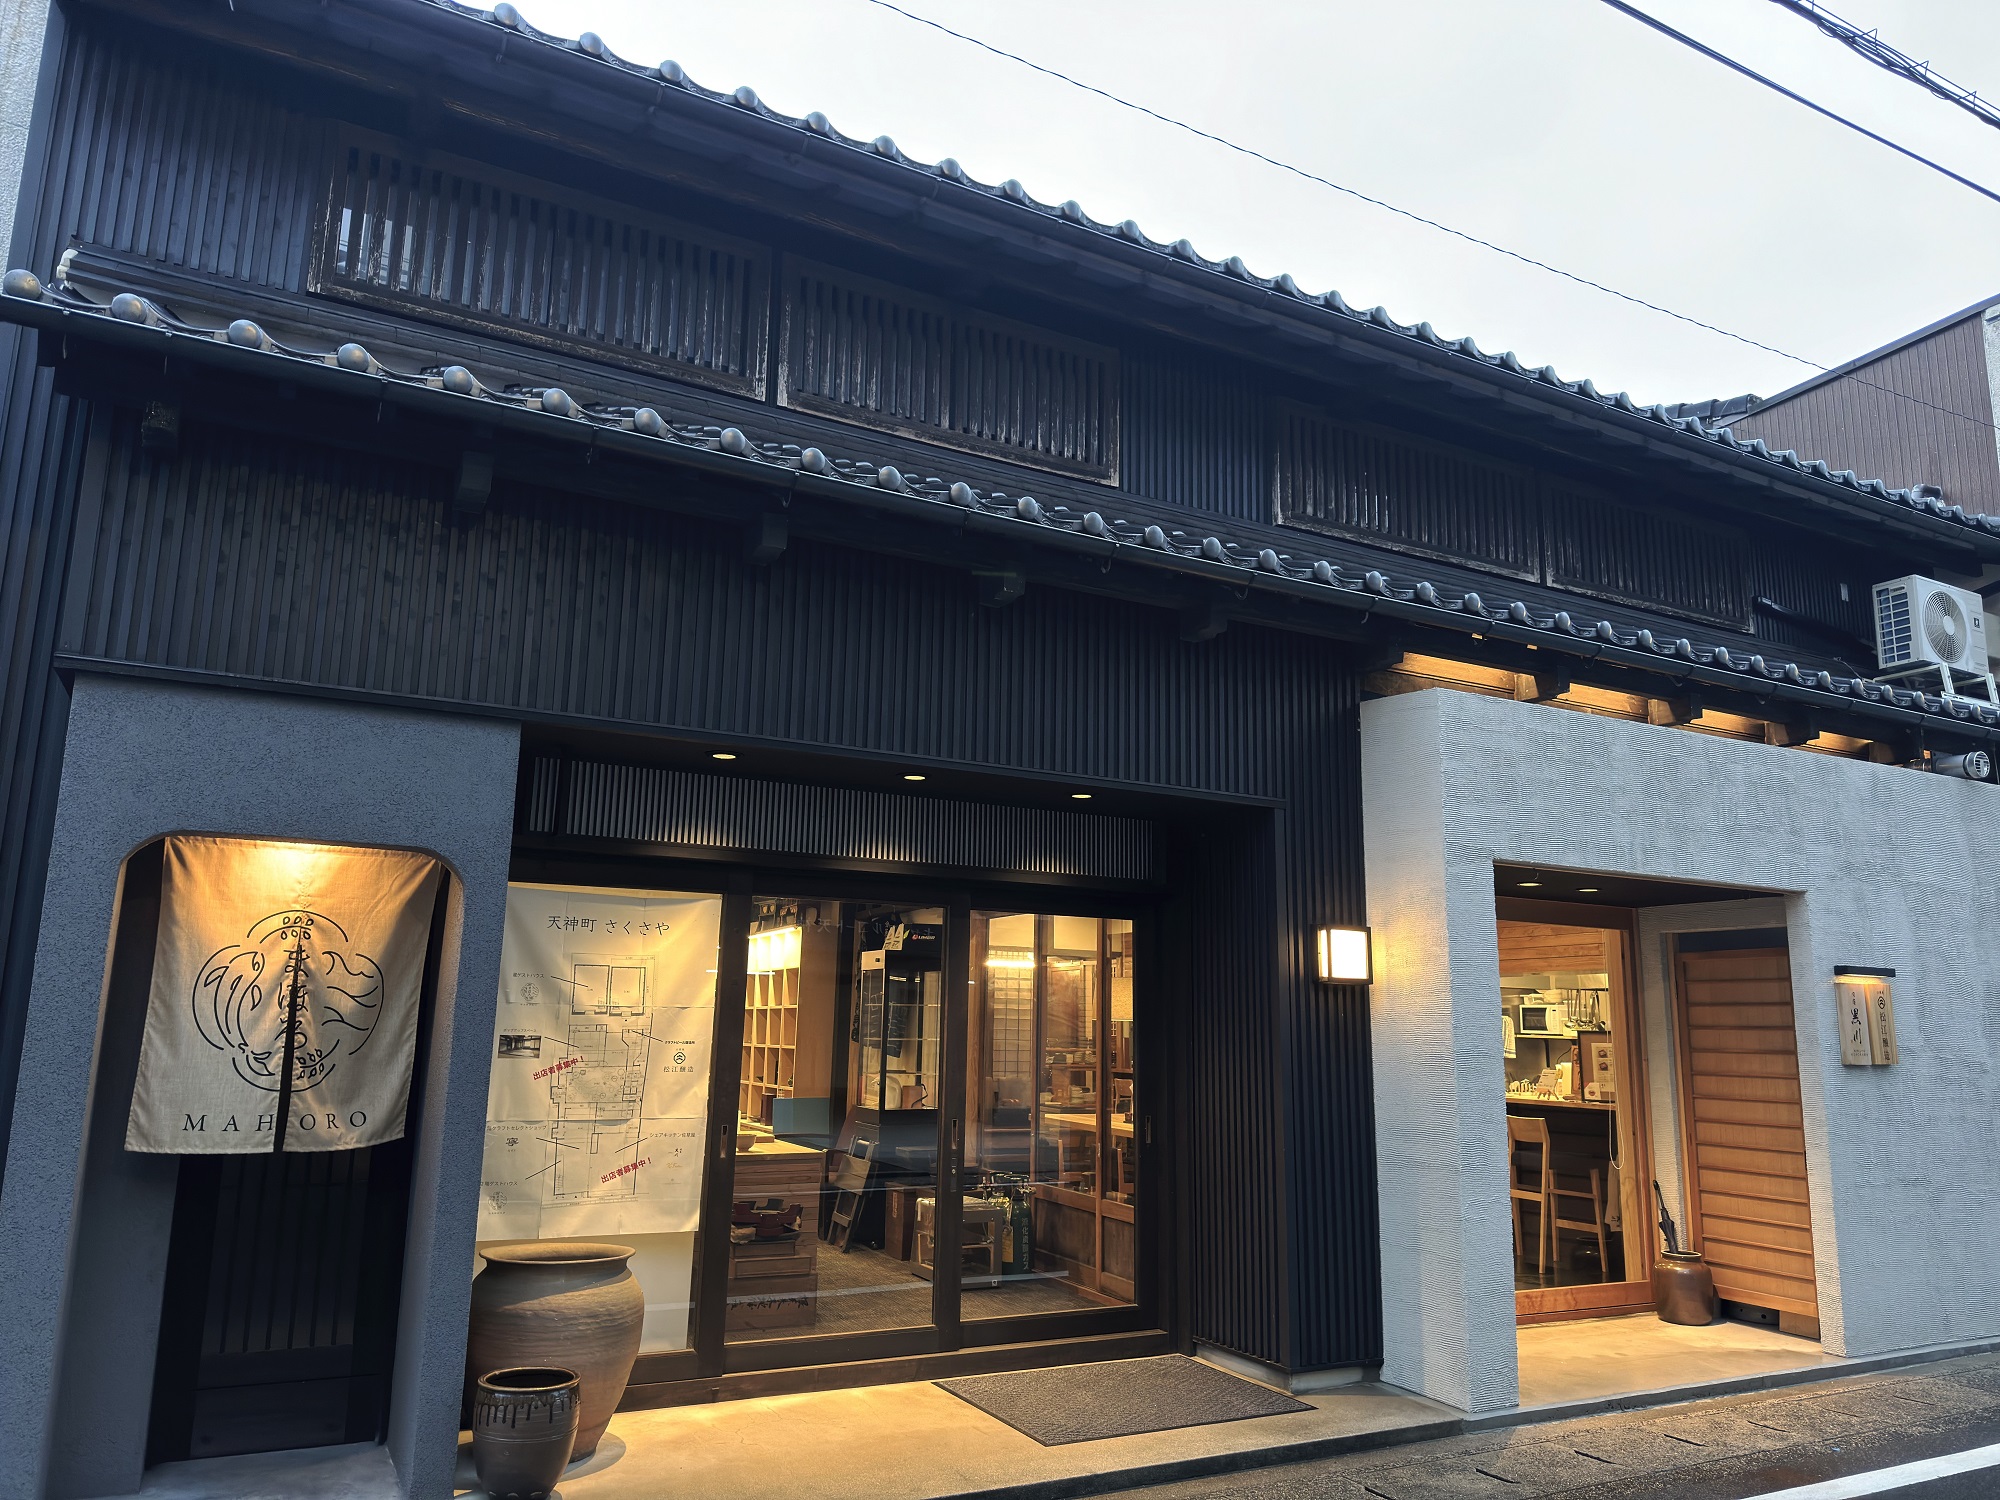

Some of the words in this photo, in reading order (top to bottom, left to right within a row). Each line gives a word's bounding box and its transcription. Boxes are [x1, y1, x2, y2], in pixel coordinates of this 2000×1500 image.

[547, 915, 597, 933] 天神町
[605, 919, 670, 936] さくさや
[182, 1110, 368, 1133] MAHORO
[600, 1156, 652, 1184] 出店者募集中！
